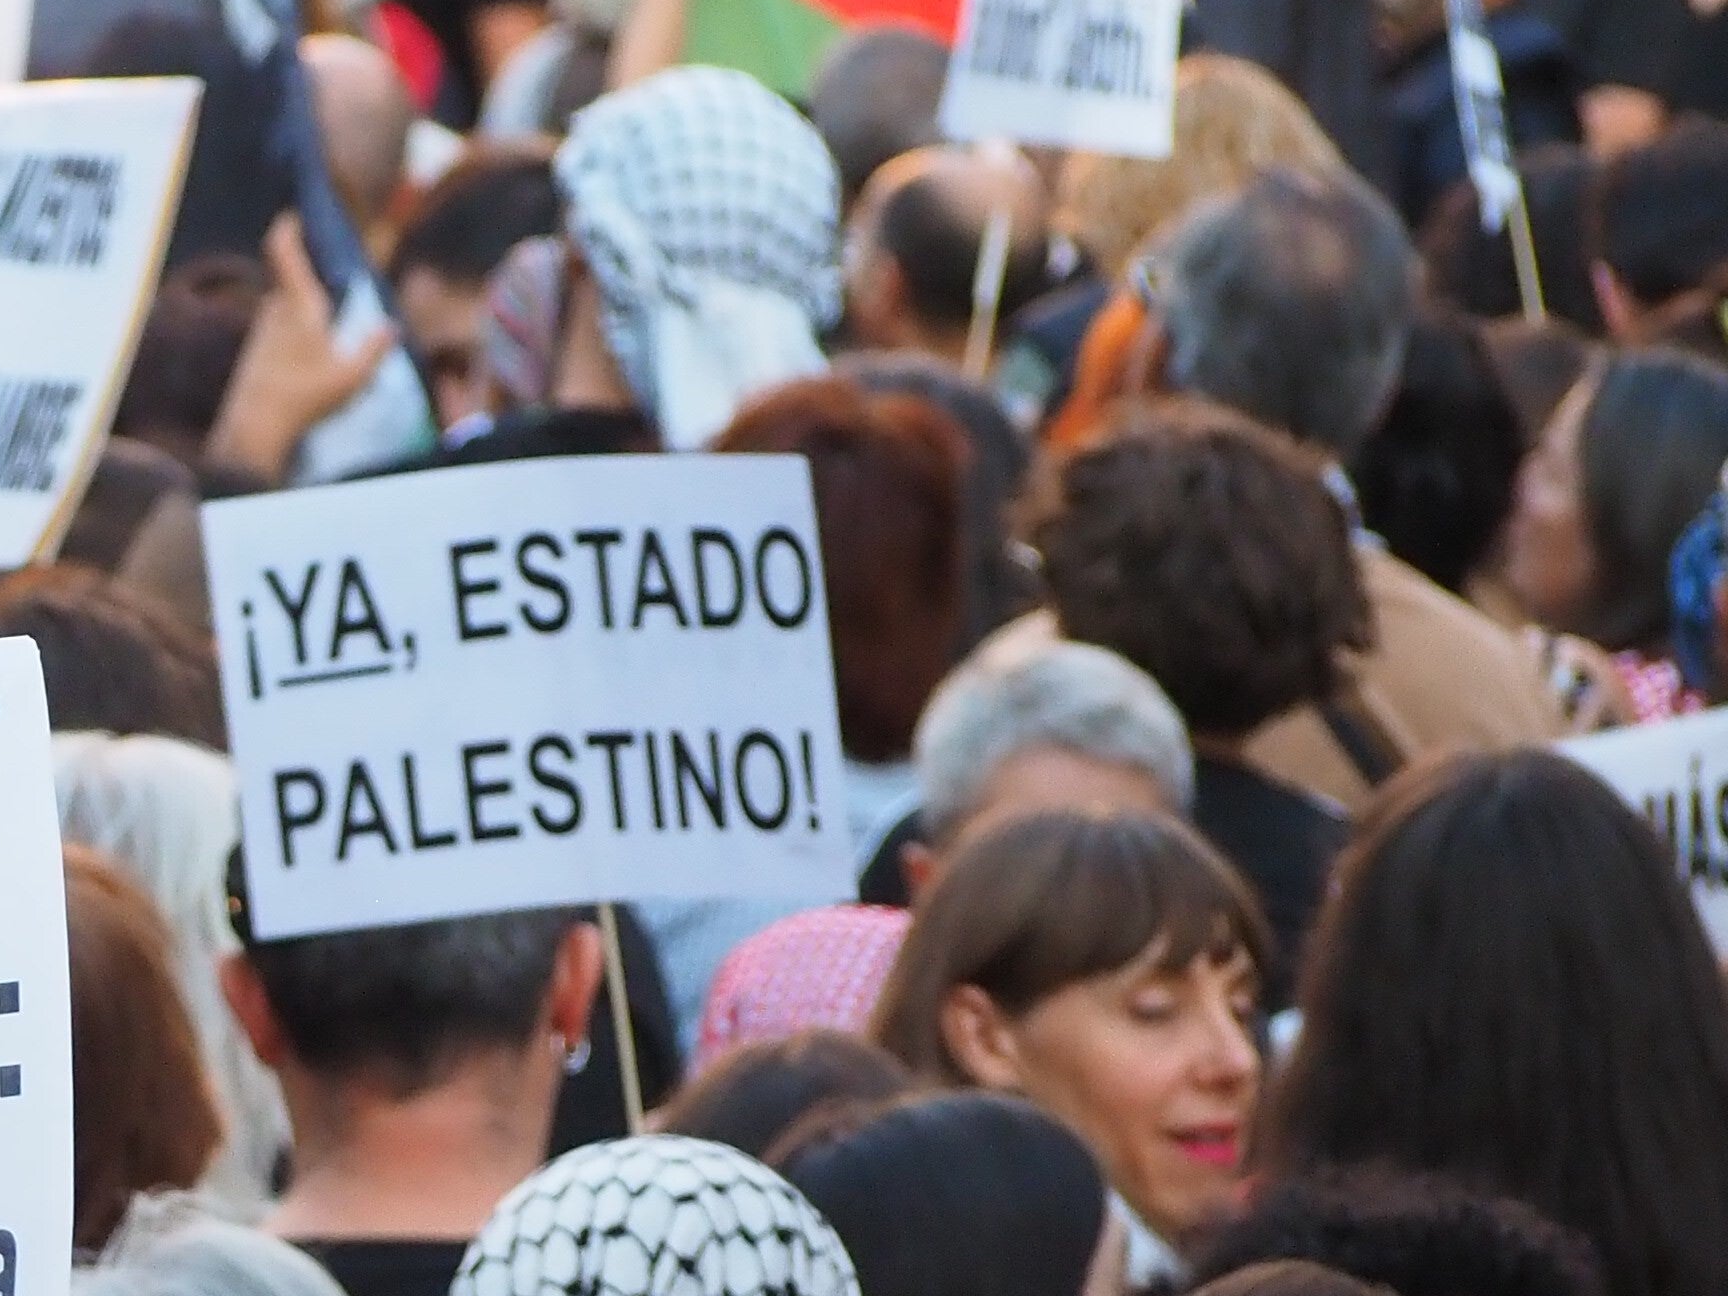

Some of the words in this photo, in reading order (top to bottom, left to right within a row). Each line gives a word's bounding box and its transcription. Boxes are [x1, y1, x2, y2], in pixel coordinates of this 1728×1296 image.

[240, 557, 417, 701] ¡YA,
[449, 526, 813, 642] ESTADO
[274, 728, 822, 868] PALESTINO!
